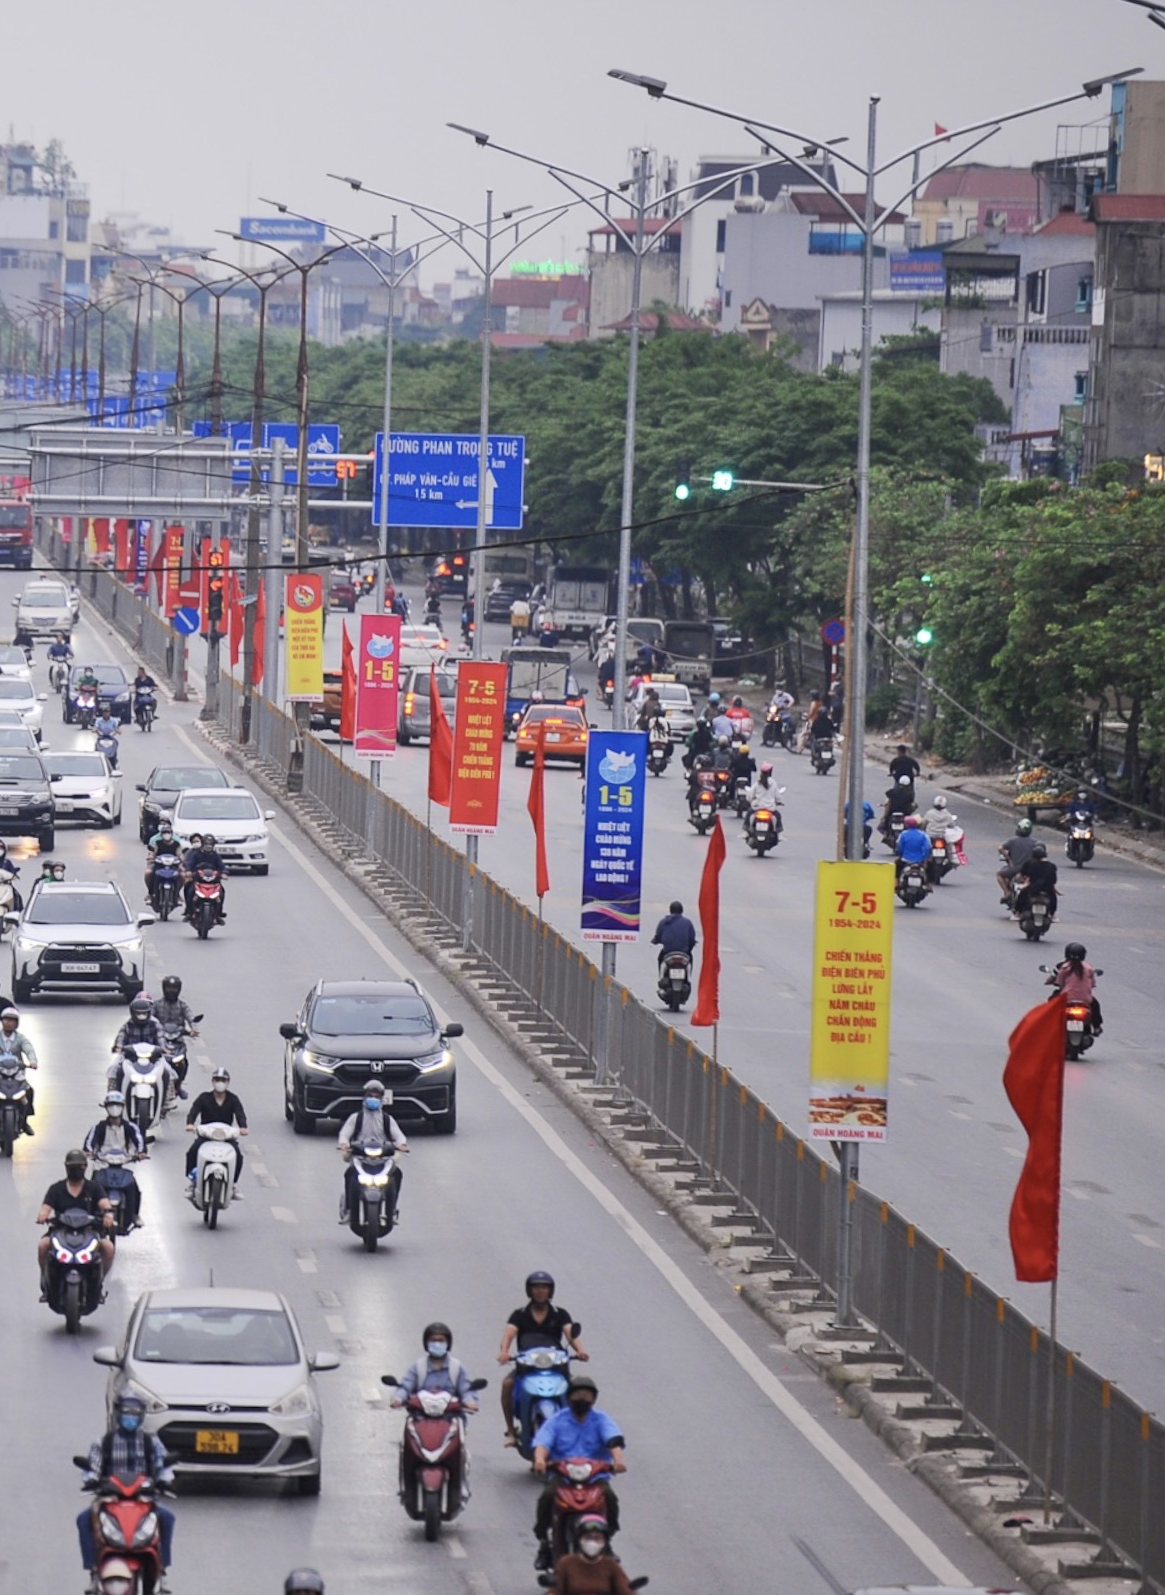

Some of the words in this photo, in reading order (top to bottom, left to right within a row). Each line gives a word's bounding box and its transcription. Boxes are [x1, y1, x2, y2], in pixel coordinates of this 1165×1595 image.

[422, 440, 452, 455] PHAN
[496, 439, 518, 459] TUỆ
[491, 457, 506, 469] km
[394, 471, 416, 486] PHÁP
[415, 488, 427, 499] 15
[429, 488, 443, 499] km
[365, 660, 394, 681] 1-5
[468, 680, 495, 696] 7-5
[599, 785, 632, 806] 1-5
[835, 891, 877, 914] 7-5
[829, 918, 882, 930] 1954-2024
[826, 949, 851, 962] CHIẾN
[854, 949, 883, 963] THẮNG
[822, 966, 842, 979] ĐIỆN
[845, 967, 865, 978] BIÊN
[868, 965, 885, 979] PHỦ
[829, 998, 850, 1010] NĂM
[852, 1000, 876, 1011] CHÂU
[827, 1013, 850, 1026] CHẤN
[853, 1015, 877, 1029] ĐỘNG
[831, 1032, 845, 1044] ĐỊA
[848, 1029, 866, 1043] CẦU
[837, 1129, 865, 1138] HOÀNG
[867, 1130, 884, 1139] MAI
